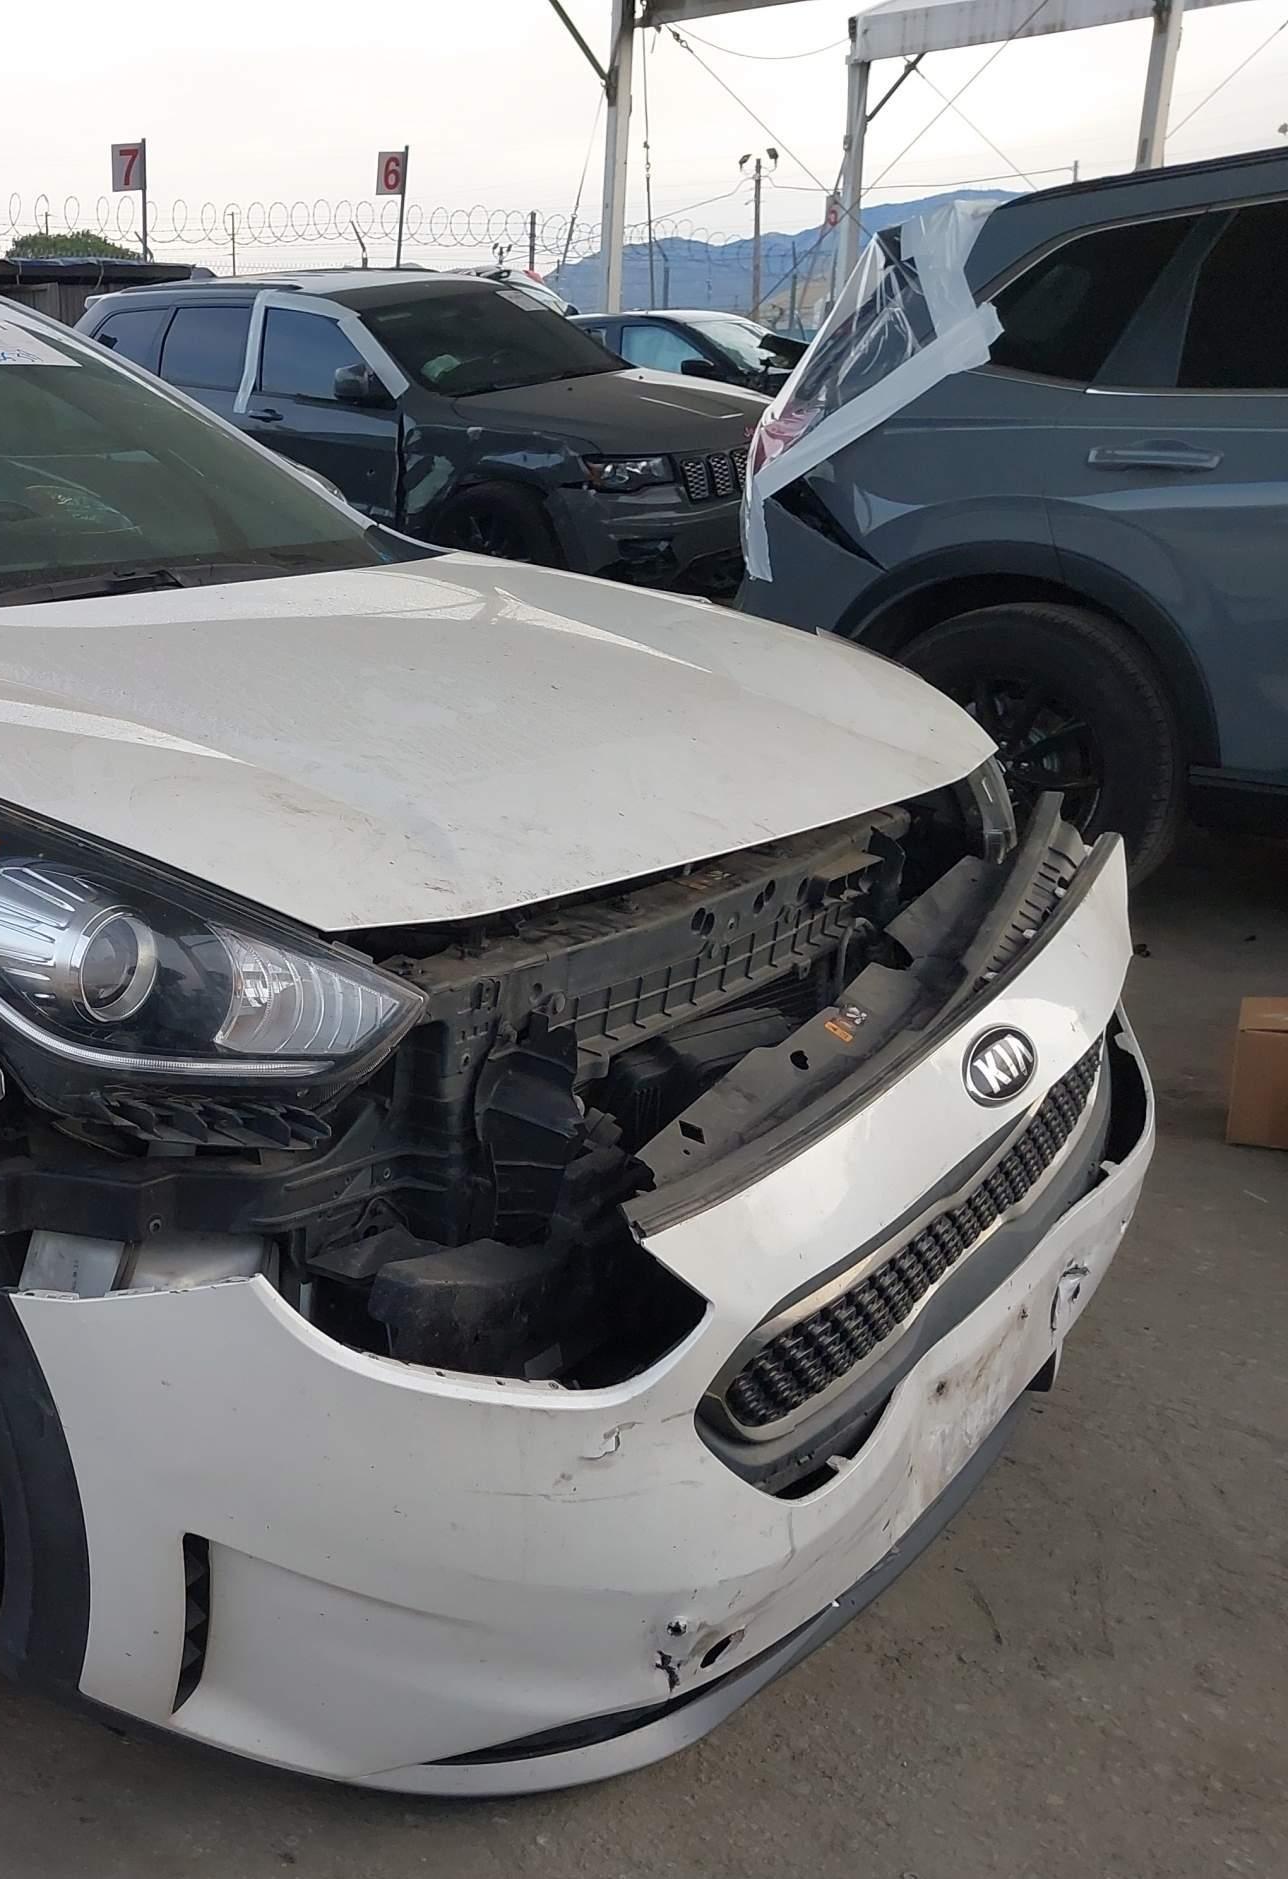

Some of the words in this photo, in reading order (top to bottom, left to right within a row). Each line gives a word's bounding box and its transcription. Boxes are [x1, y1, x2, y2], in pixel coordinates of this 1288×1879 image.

[119, 149, 139, 186] 7
[384, 156, 400, 190] 6
[972, 1033, 1033, 1094] KIA
